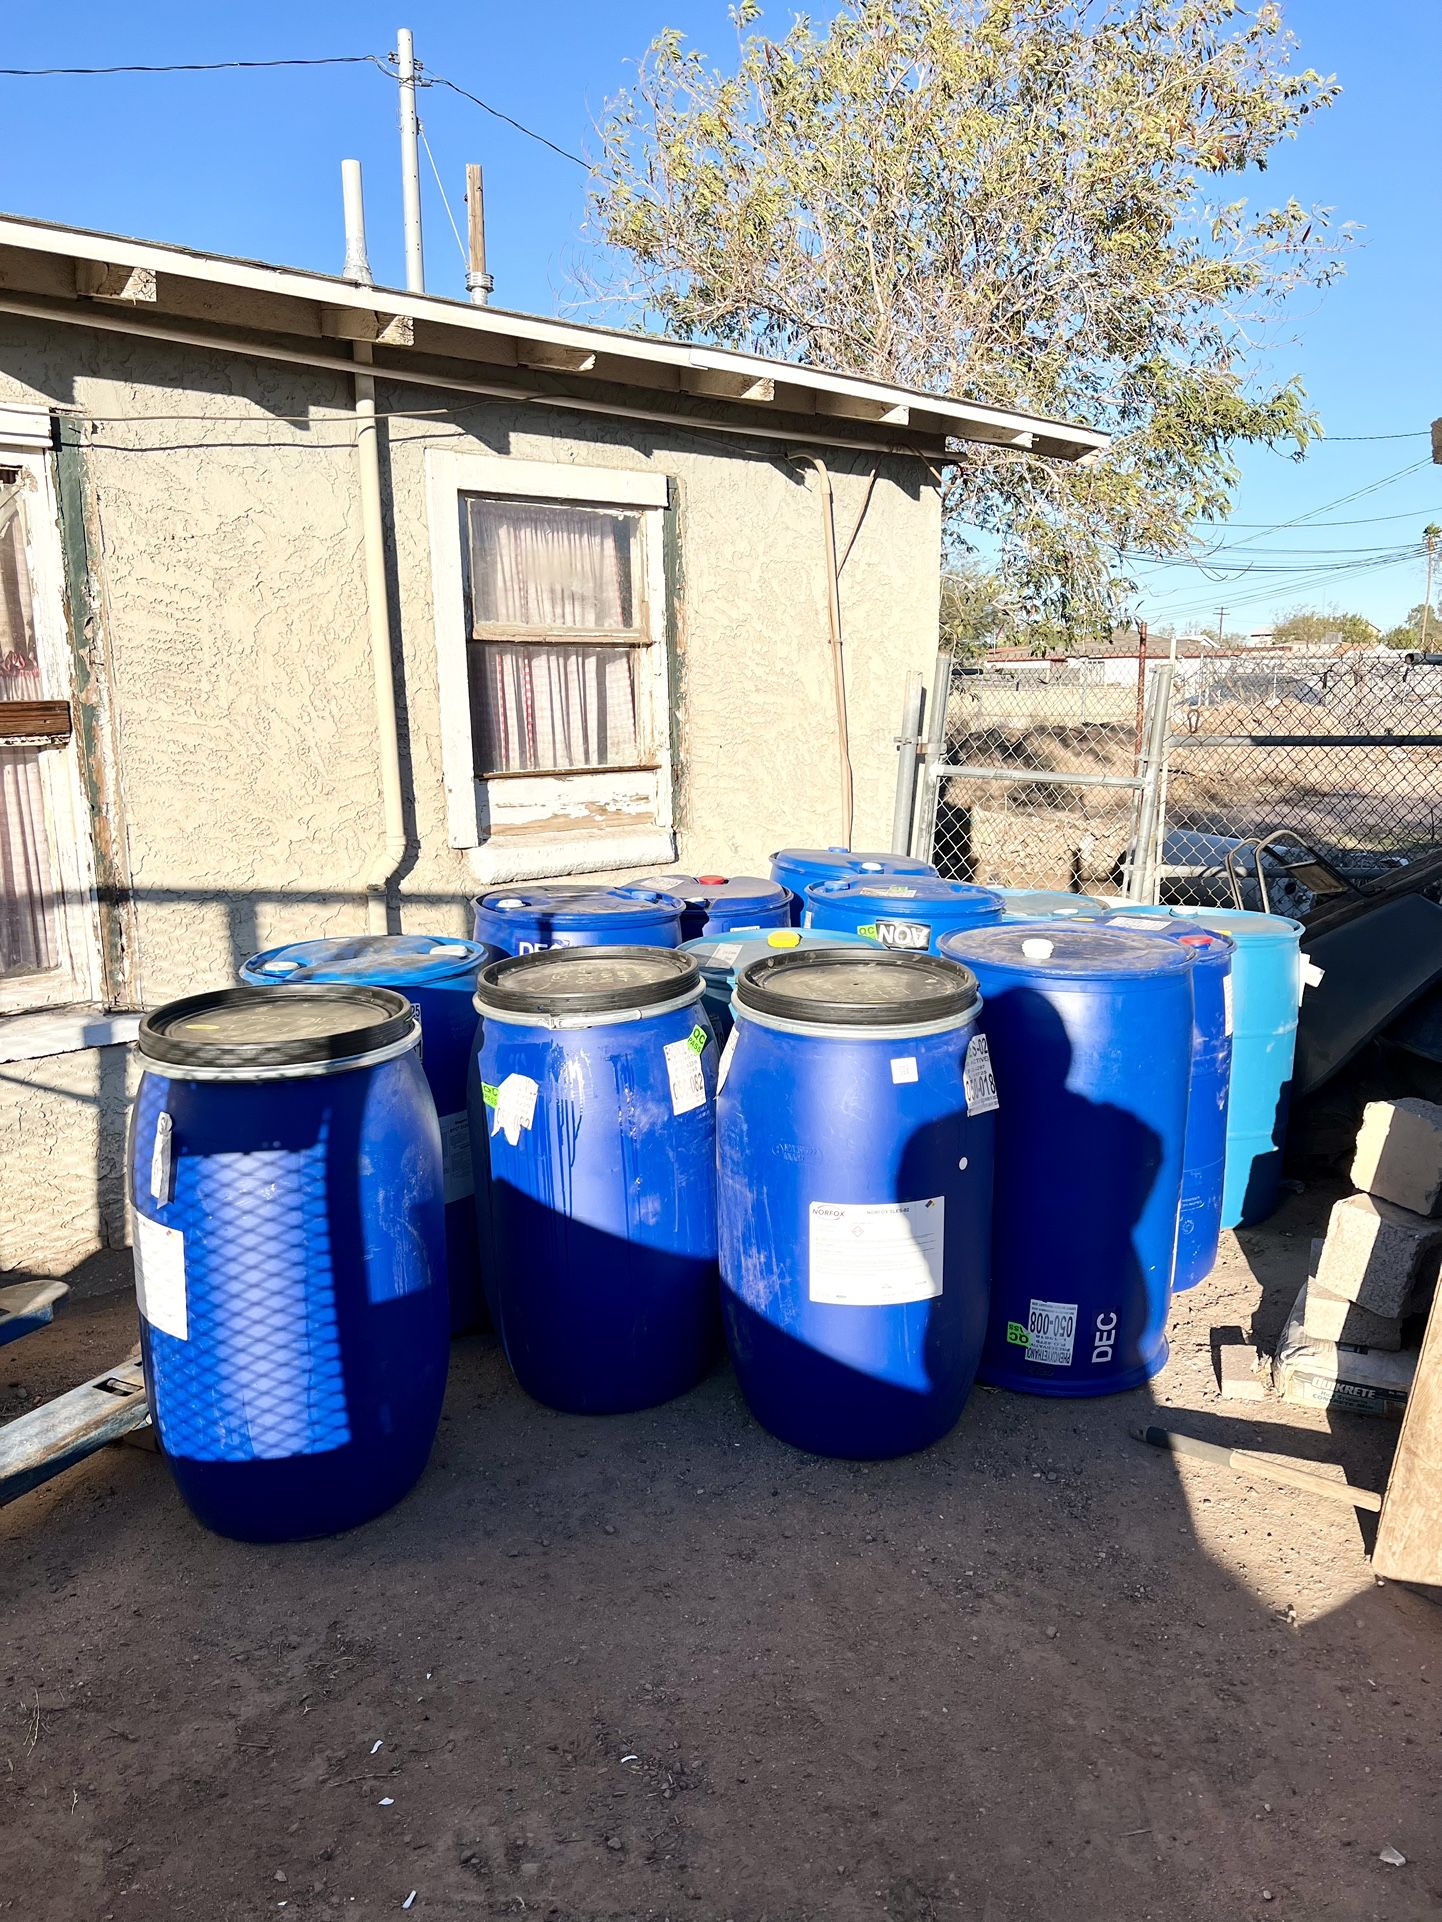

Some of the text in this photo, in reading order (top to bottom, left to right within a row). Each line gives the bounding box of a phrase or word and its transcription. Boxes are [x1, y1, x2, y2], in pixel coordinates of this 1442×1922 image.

[858, 926, 876, 936] QC
[687, 1036, 702, 1053] PASS
[692, 1027, 706, 1045] QC
[483, 1085, 499, 1097] QC
[812, 1207, 845, 1218] NORFOX
[1029, 1311, 1073, 1338] 050-008
[1008, 1331, 1029, 1344] QC
[1091, 1312, 1118, 1363] DEC
[1311, 1376, 1376, 1400] QUIKRETE
